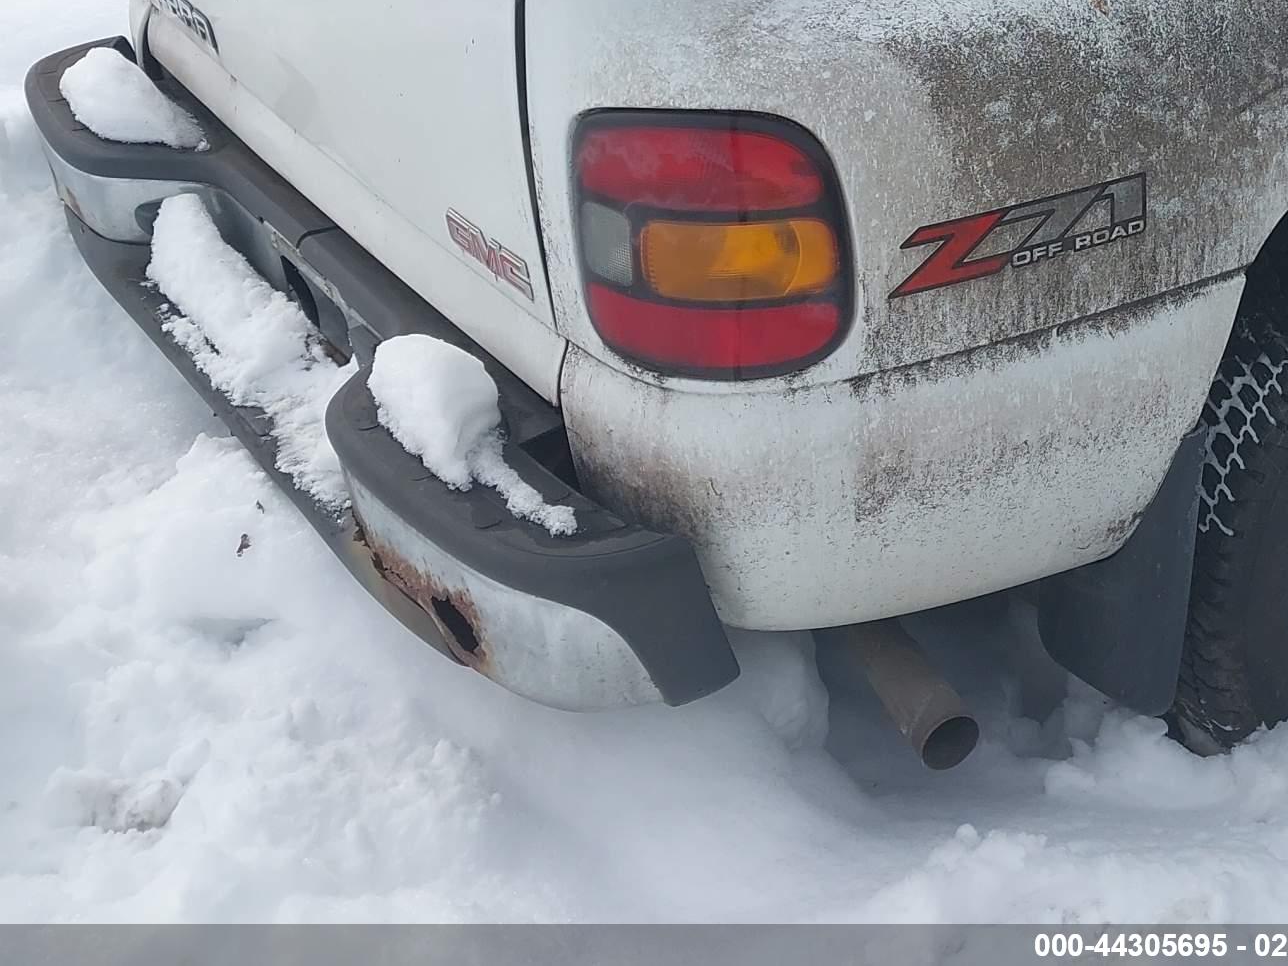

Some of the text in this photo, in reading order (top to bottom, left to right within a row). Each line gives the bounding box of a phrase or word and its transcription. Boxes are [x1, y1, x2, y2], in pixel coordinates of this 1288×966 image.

[446, 207, 534, 301] GMC
[888, 172, 1146, 299] Z71
[1011, 219, 1146, 267] OFF ROAD
